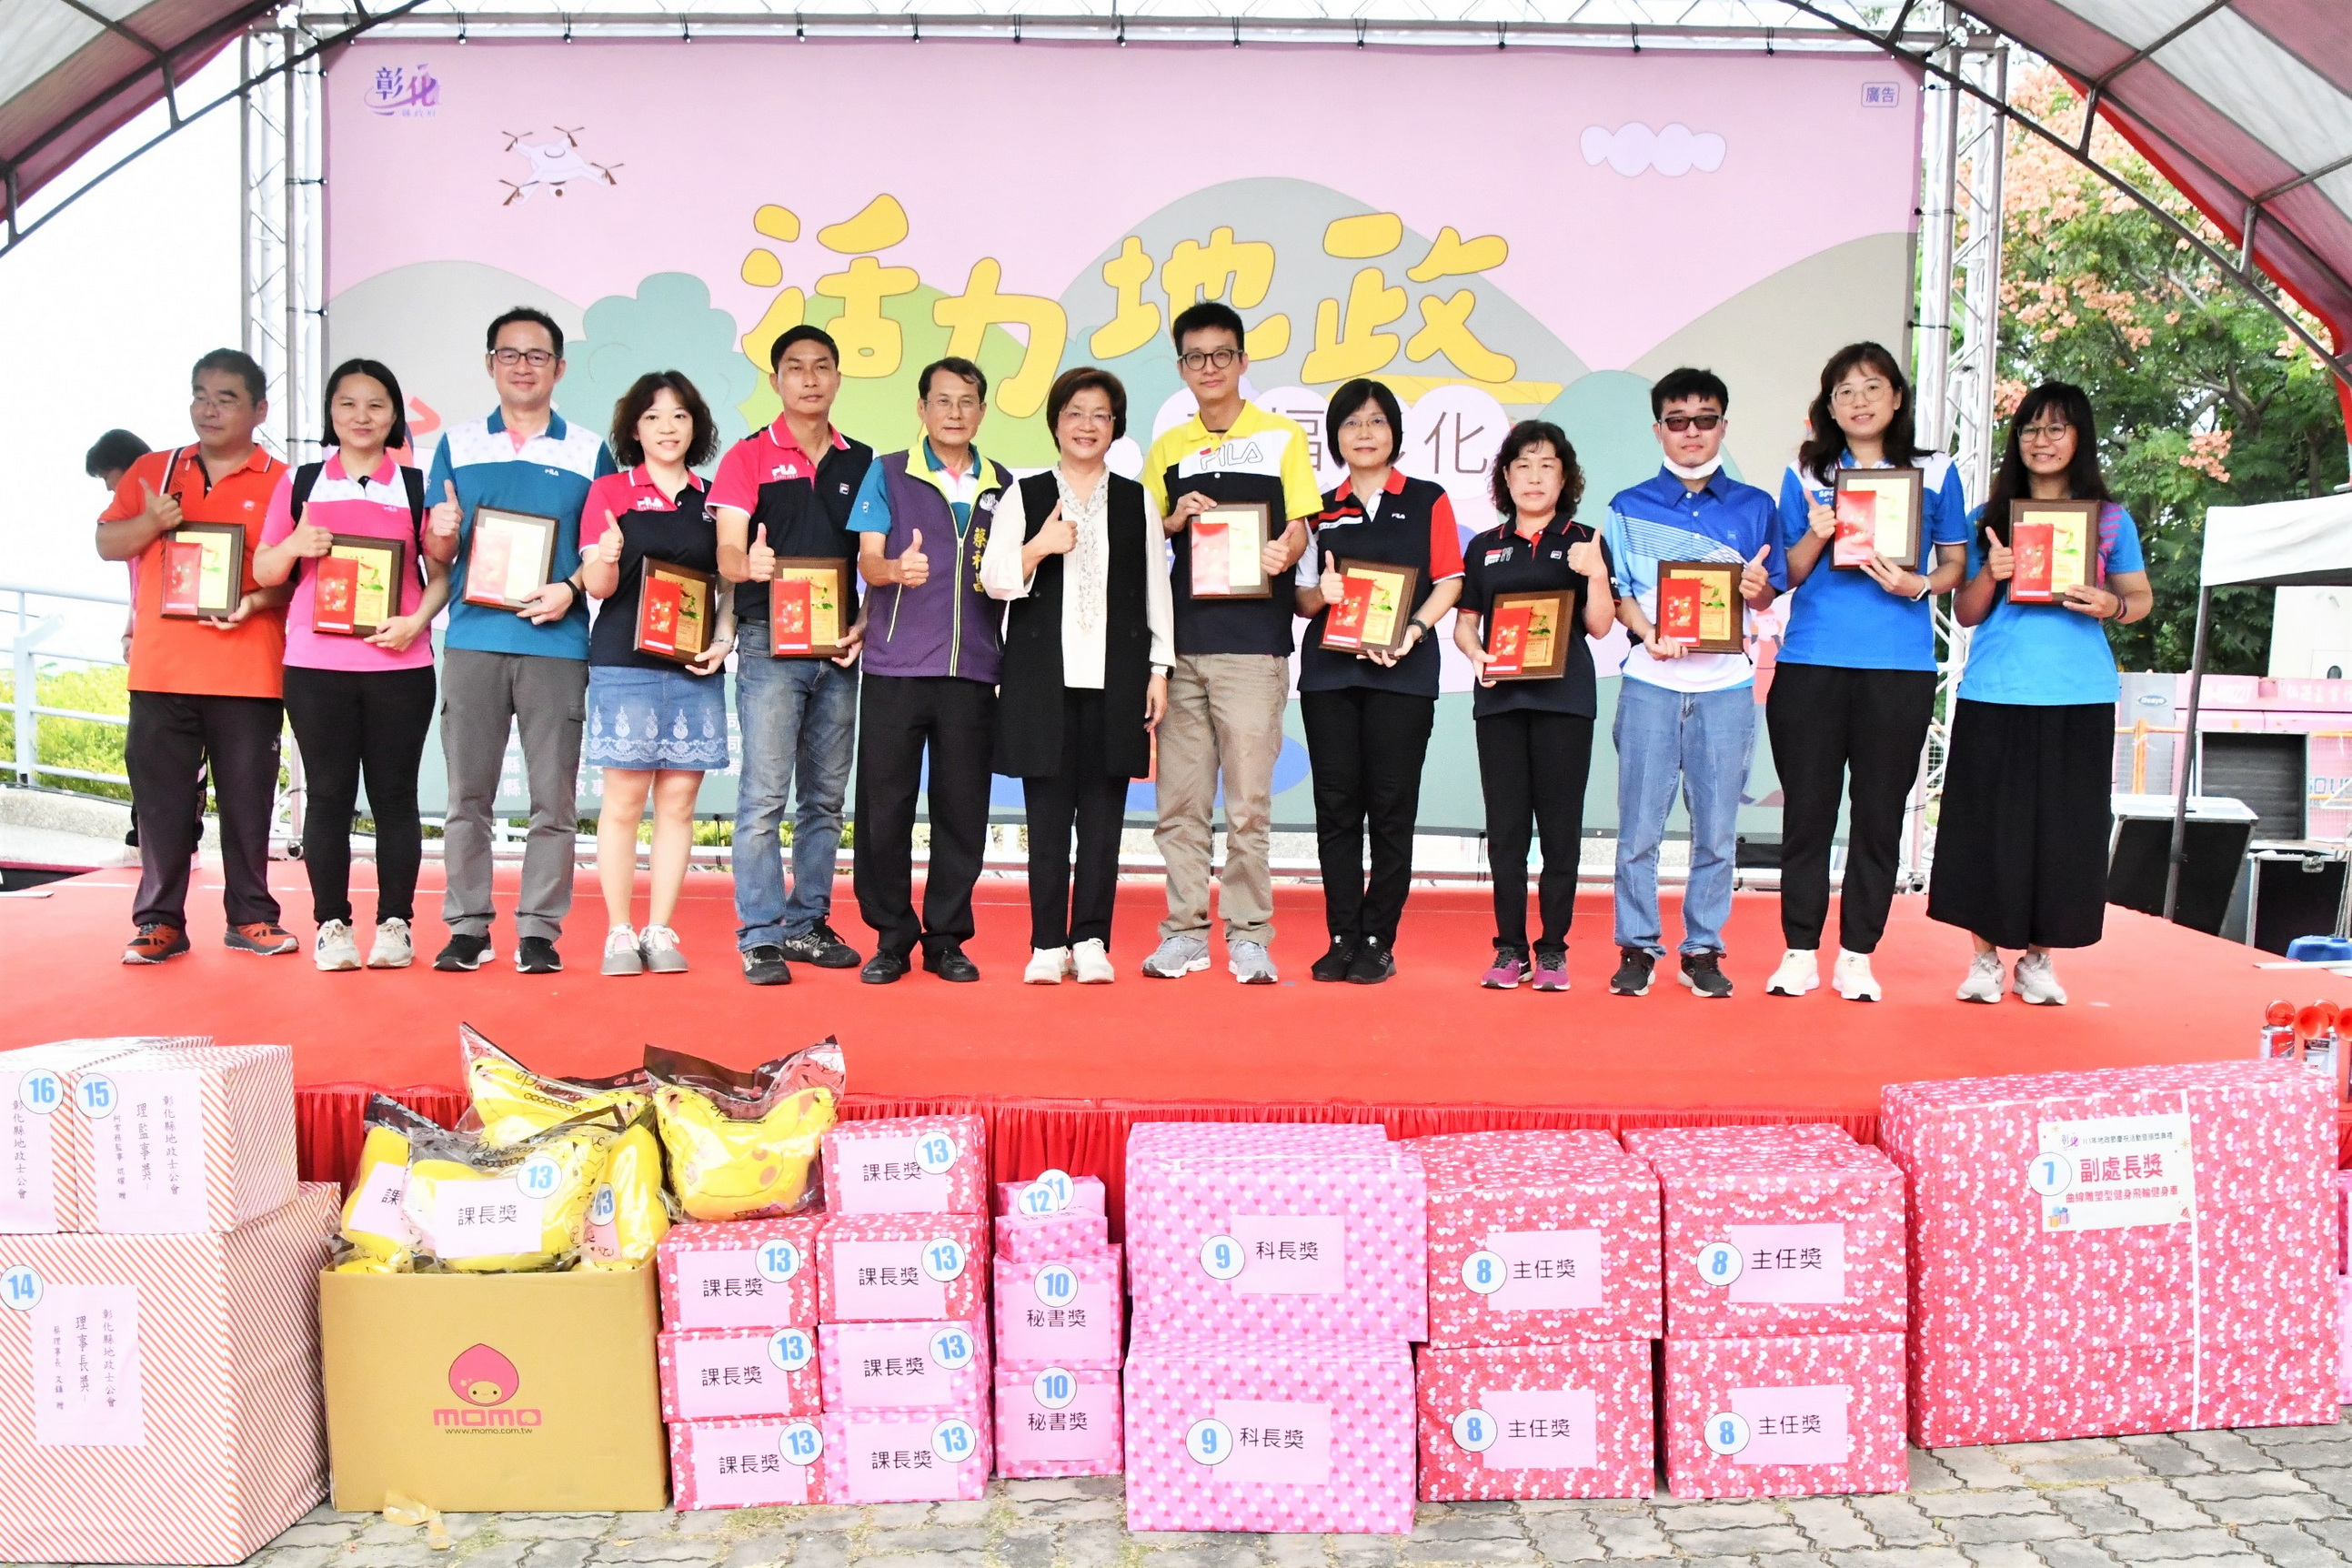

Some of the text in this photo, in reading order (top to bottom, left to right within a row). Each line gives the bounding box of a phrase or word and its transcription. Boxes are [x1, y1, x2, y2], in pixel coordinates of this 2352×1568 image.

[1866, 86, 1895, 103] 廣告
[740, 193, 1518, 419] 活力地政
[1200, 441, 1264, 470] FILA
[771, 463, 798, 476] FILA
[637, 496, 663, 507] FILA
[28, 1077, 55, 1103] 16
[84, 1081, 110, 1107] 15
[12, 1100, 27, 1200] 彰化縣地政士公會
[136, 1102, 152, 1181] 理監事獎
[163, 1095, 180, 1196] 彰化縣地政士公會
[922, 1139, 950, 1165] 13
[527, 1165, 553, 1190] 13
[862, 1161, 921, 1182] 課長獎
[2042, 1161, 2055, 1186] 7
[2080, 1152, 2164, 1183] 副處長獎
[381, 1188, 401, 1206] 課
[1026, 1190, 1052, 1212] 12
[457, 1204, 518, 1227] 課長獎
[765, 1248, 792, 1273] 13
[930, 1246, 958, 1271] 13
[1215, 1241, 1319, 1270] 9 科長獎
[1711, 1246, 1823, 1276] 8 主任獎
[858, 1266, 920, 1288] 課長獎
[1476, 1258, 1576, 1284] 8 主任獎
[8, 1274, 35, 1300] 14
[702, 1277, 764, 1299] 課長獎
[1044, 1272, 1070, 1298] 10
[1027, 1308, 1087, 1329] 秘書獎
[75, 1315, 89, 1392] 理事長獎
[102, 1309, 116, 1408] 彰化縣地政士公會
[777, 1336, 804, 1361] 13
[939, 1335, 966, 1361] 13
[700, 1366, 763, 1387] 課長獎
[863, 1356, 925, 1378] 課長獎
[1042, 1374, 1069, 1401] 10
[433, 1409, 541, 1426] momo
[1028, 1411, 1088, 1432] 秘書獎
[1467, 1416, 1571, 1442] 8 主任獎
[1719, 1414, 1823, 1445] 8 主任獎
[788, 1429, 815, 1455] 13
[942, 1427, 970, 1452] 13
[1201, 1427, 1303, 1453] 9 科長獎
[718, 1453, 781, 1475] 課長獎
[870, 1451, 932, 1471] 課長獎
